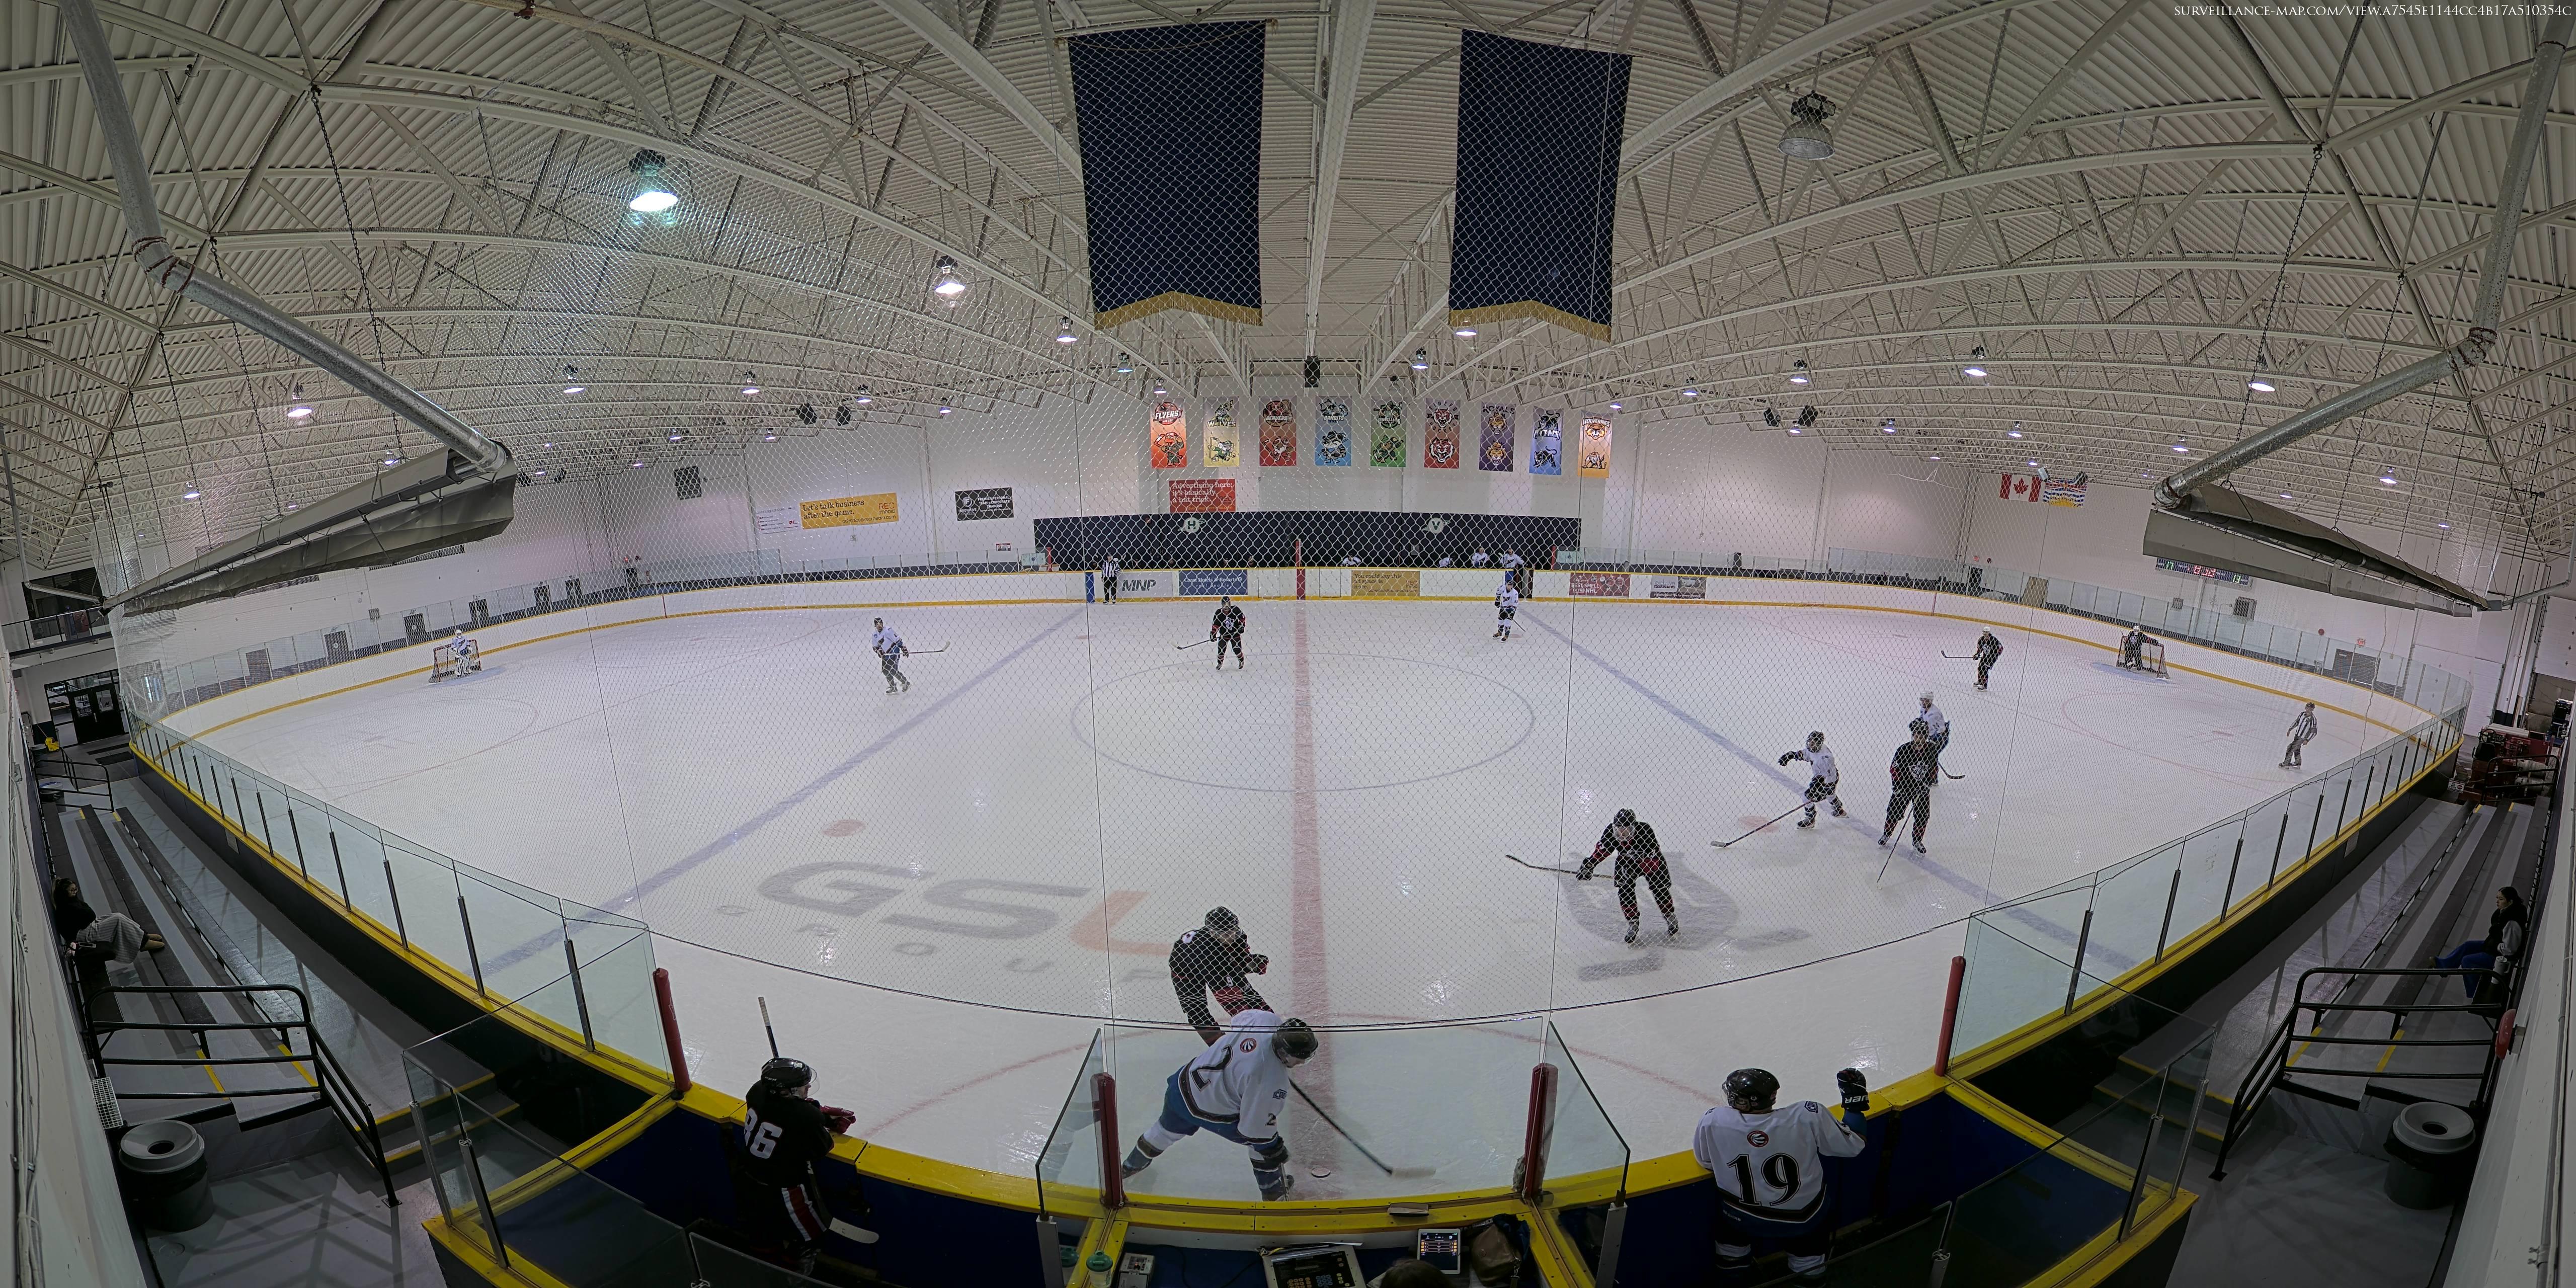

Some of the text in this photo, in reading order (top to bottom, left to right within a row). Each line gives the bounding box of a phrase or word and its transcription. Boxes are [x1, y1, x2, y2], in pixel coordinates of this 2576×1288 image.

[1155, 410, 1179, 420] FLYERS
[1482, 406, 1515, 414] ROYALS
[1582, 417, 1611, 427] WOLVERINES
[1534, 429, 1560, 438] ATTACK
[802, 499, 865, 511] Let's talk business
[834, 509, 855, 517] game.
[1122, 579, 1156, 592] MNP
[1191, 1044, 1234, 1092] 2
[1265, 1112, 1277, 1126] 2
[1726, 1152, 1802, 1206] 19
